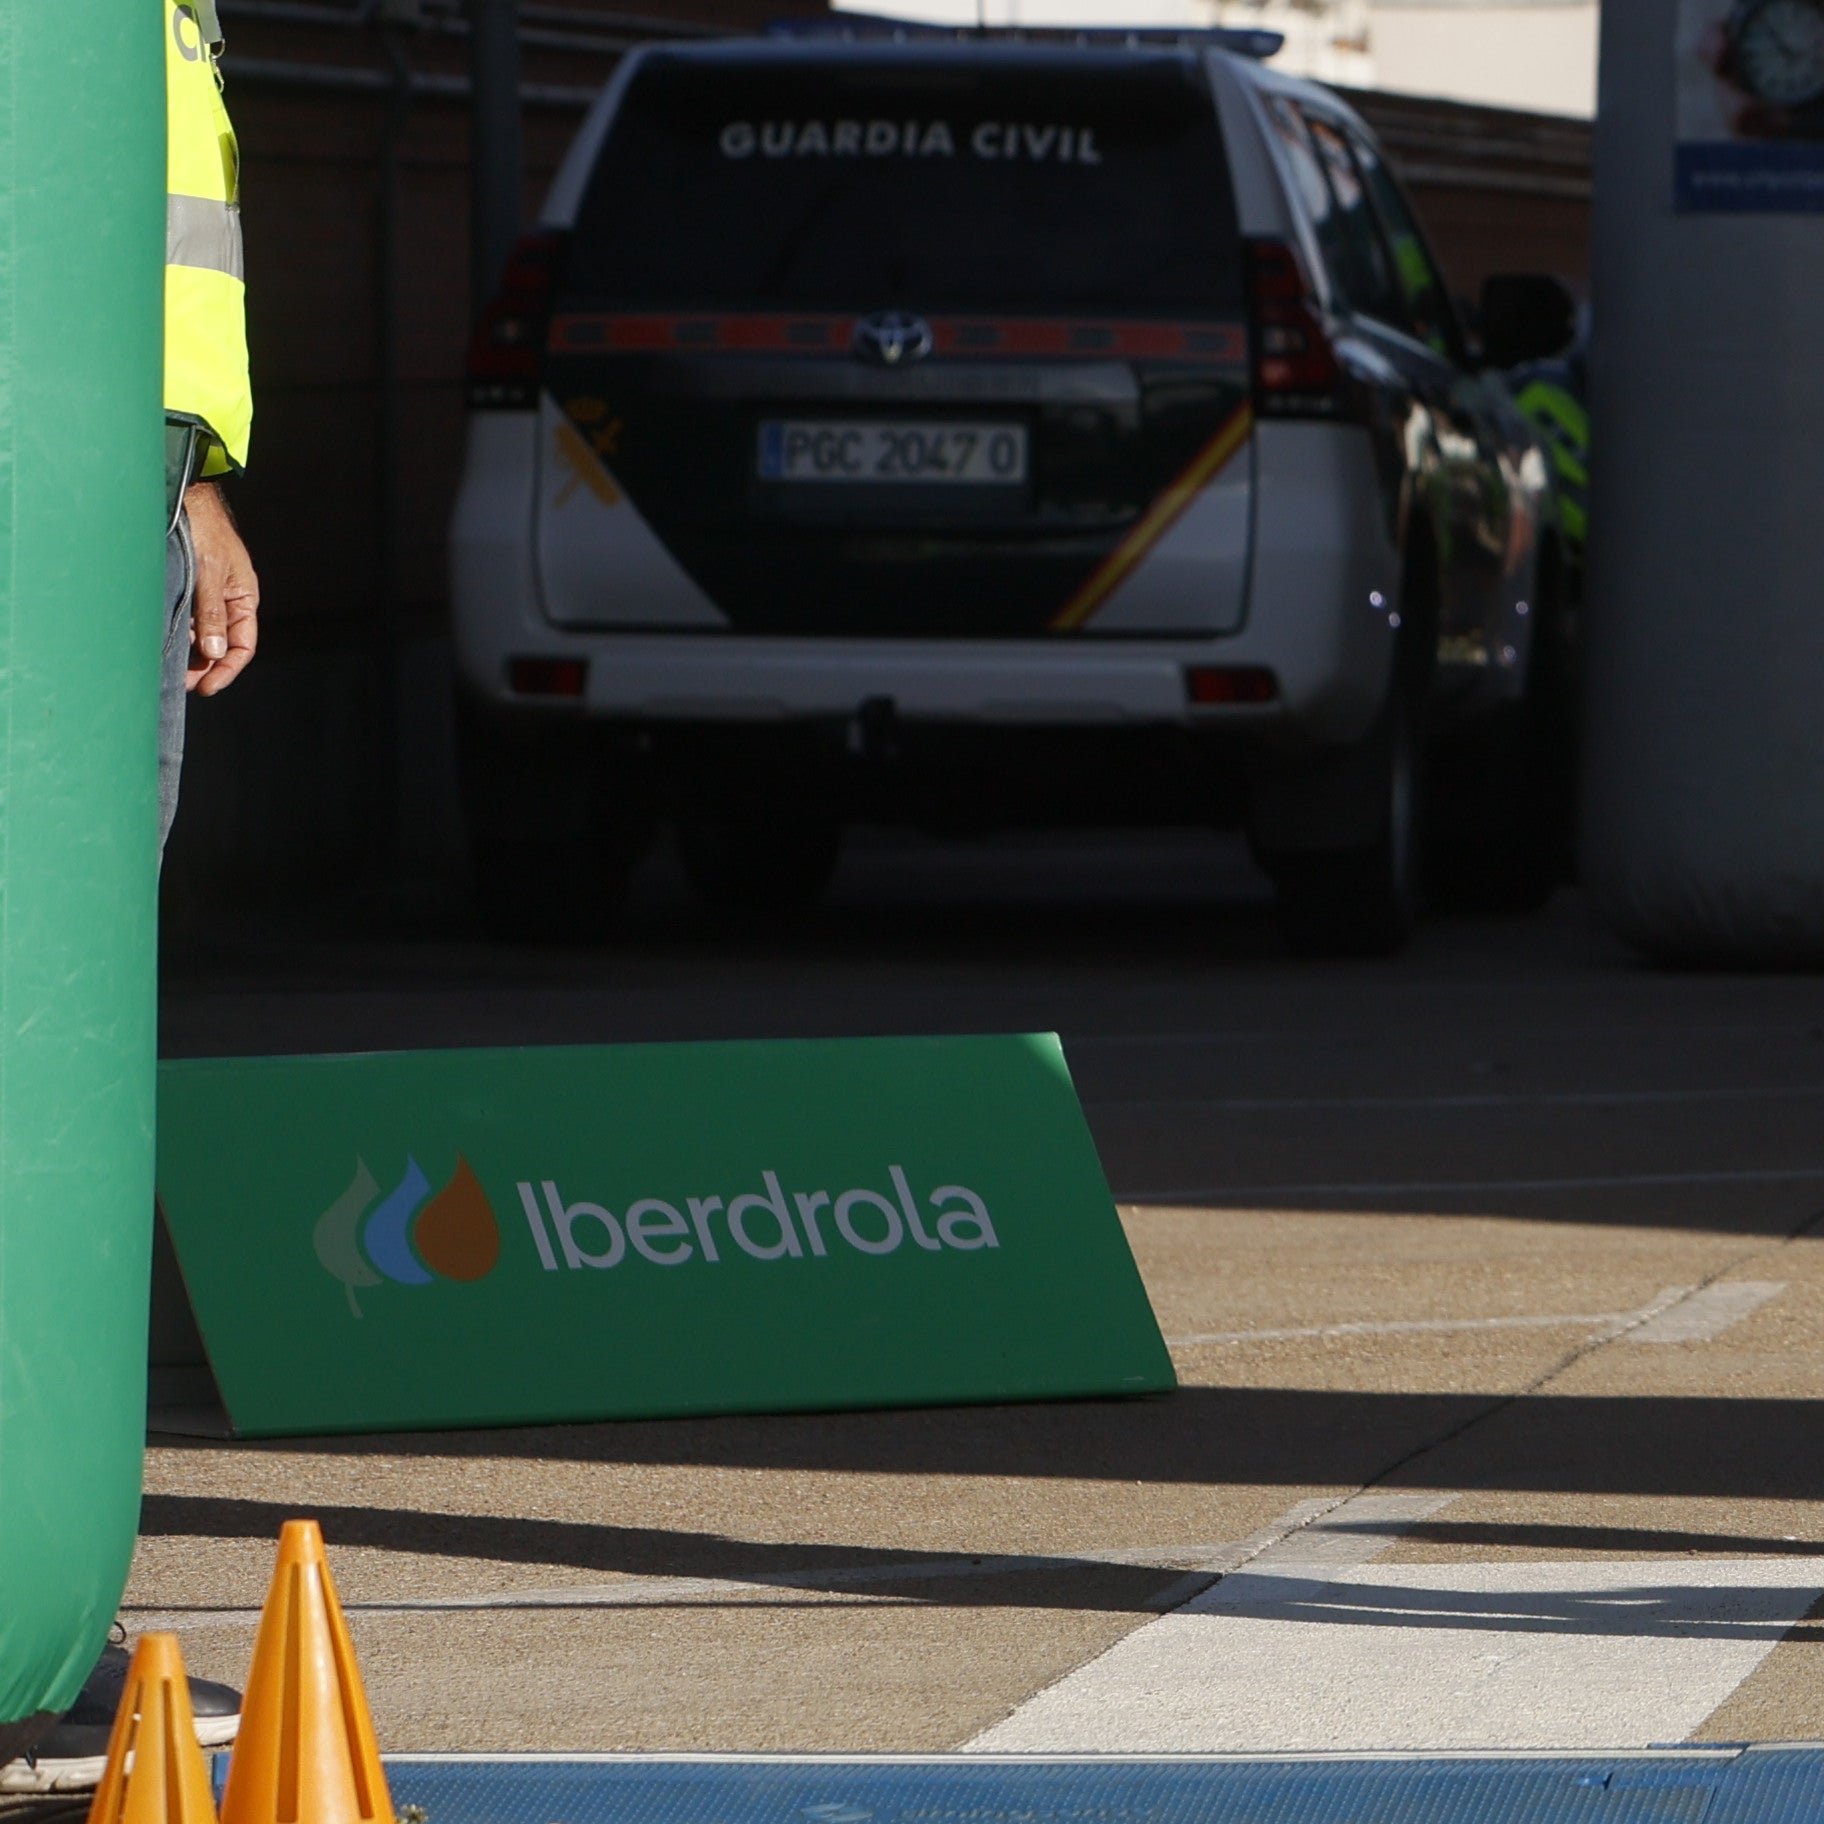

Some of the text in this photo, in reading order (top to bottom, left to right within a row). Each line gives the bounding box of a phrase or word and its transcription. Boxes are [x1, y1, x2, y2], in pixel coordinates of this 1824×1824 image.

[720, 119, 1103, 165] GUARDIA CIVIL
[786, 429, 864, 473] PGC
[877, 430, 979, 474] 2047
[515, 1164, 1000, 1272] Iberdrola
